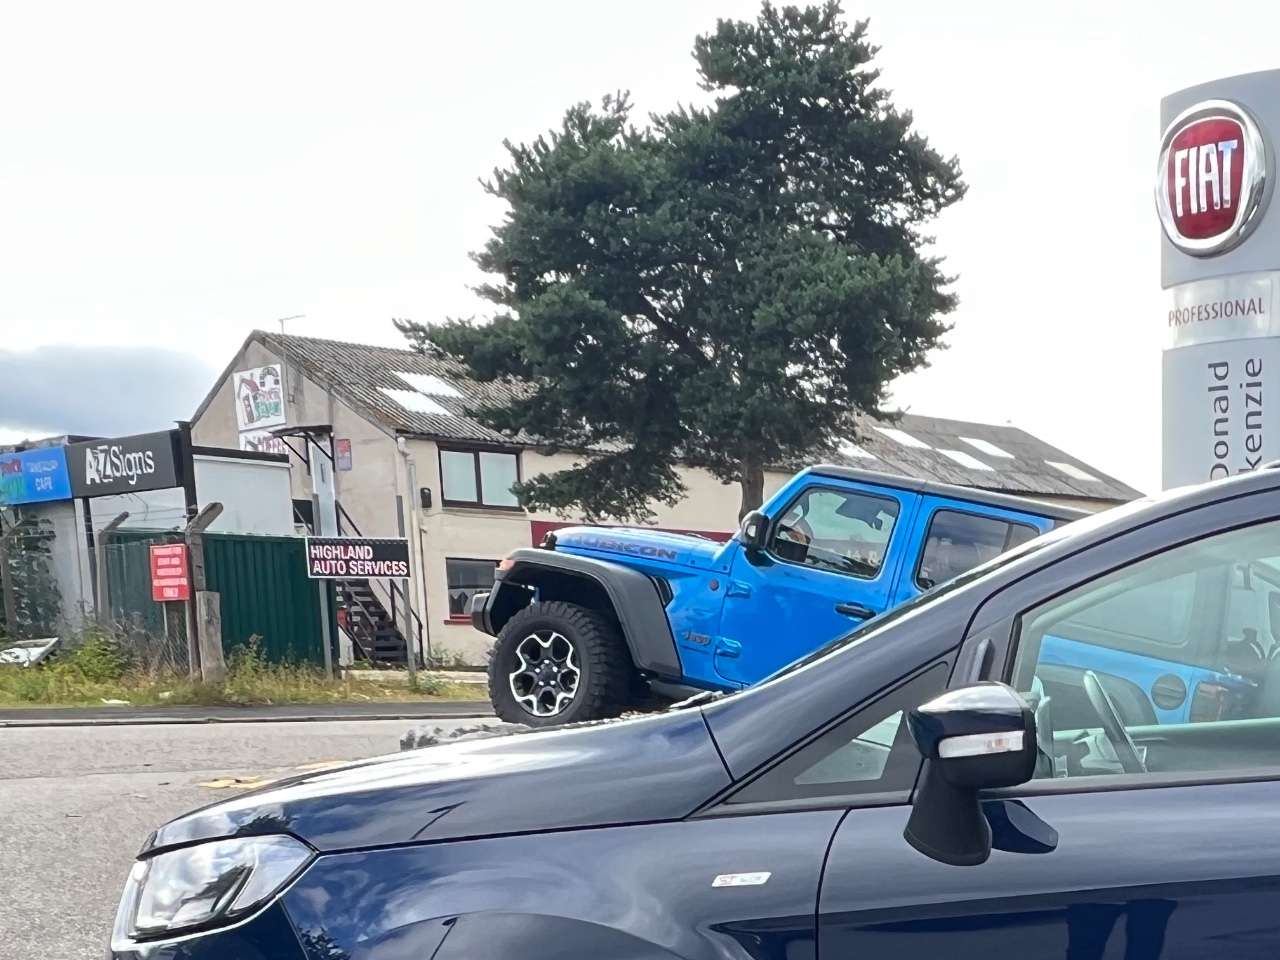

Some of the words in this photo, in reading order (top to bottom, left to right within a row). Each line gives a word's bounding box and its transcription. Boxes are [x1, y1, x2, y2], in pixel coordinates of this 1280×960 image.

[1174, 138, 1238, 217] FIAT
[1168, 296, 1265, 328] PROFESSIONAL
[310, 545, 374, 560] HIGHLAND
[313, 560, 347, 575] AUTO
[349, 560, 408, 576] SERVICES
